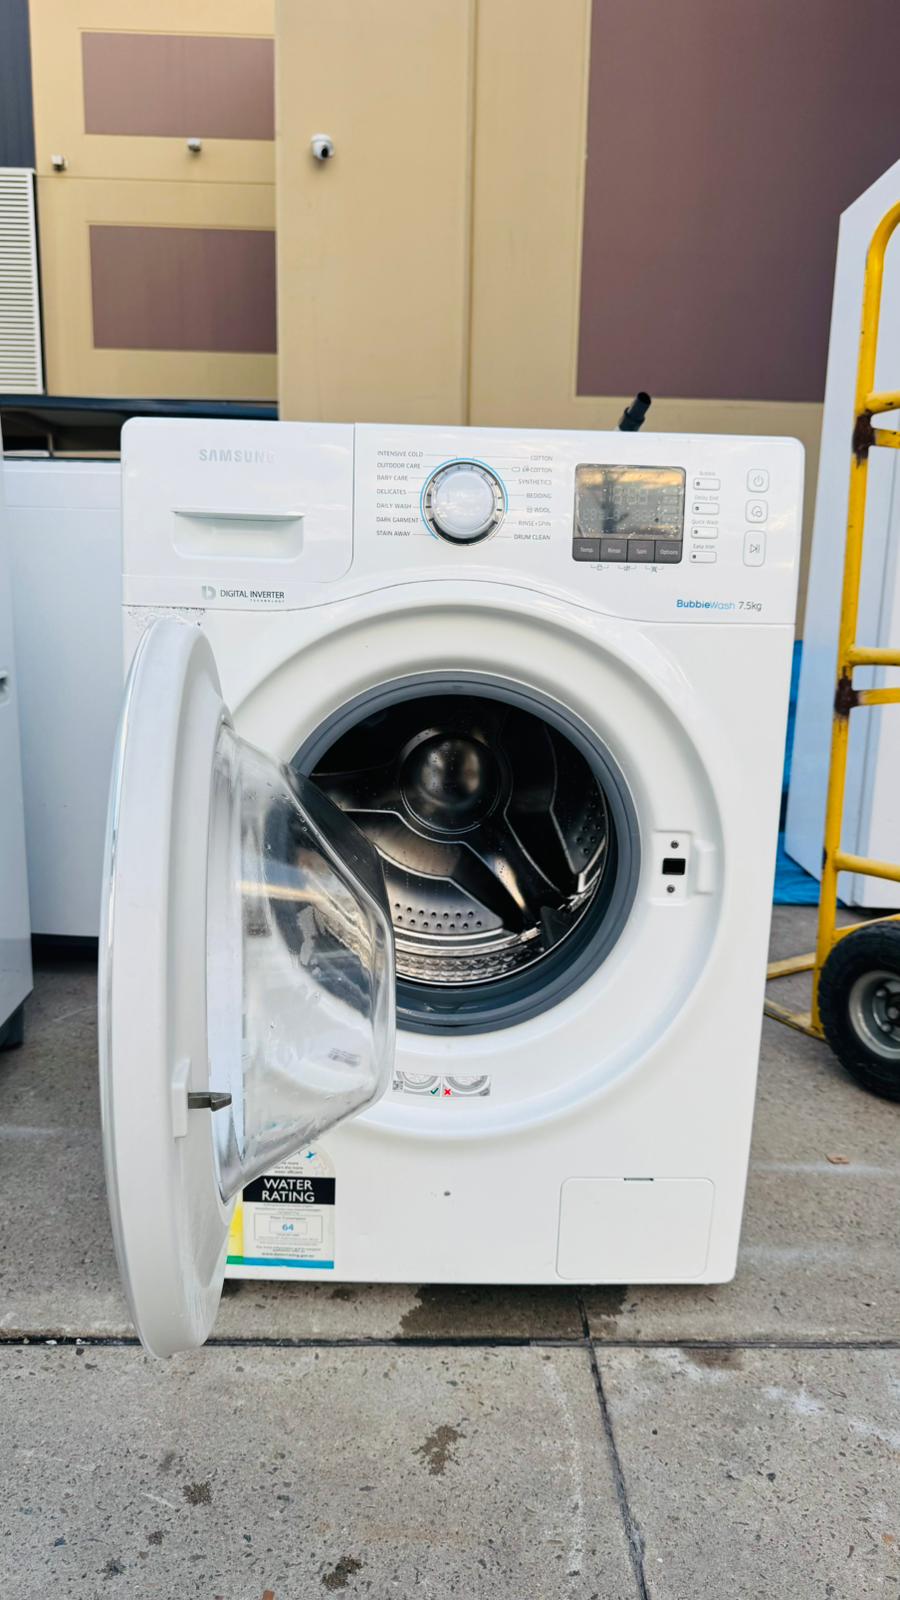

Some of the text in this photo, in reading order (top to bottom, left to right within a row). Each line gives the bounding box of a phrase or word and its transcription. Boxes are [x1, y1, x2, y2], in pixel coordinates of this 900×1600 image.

[199, 448, 275, 464] SAMSUNG
[220, 589, 248, 598] DIGITAL
[250, 590, 285, 599] INVERTER
[738, 601, 762, 612] 7.5kg
[263, 1178, 313, 1191] WATER
[261, 1190, 315, 1203] RATING
[282, 1223, 294, 1232] 64
